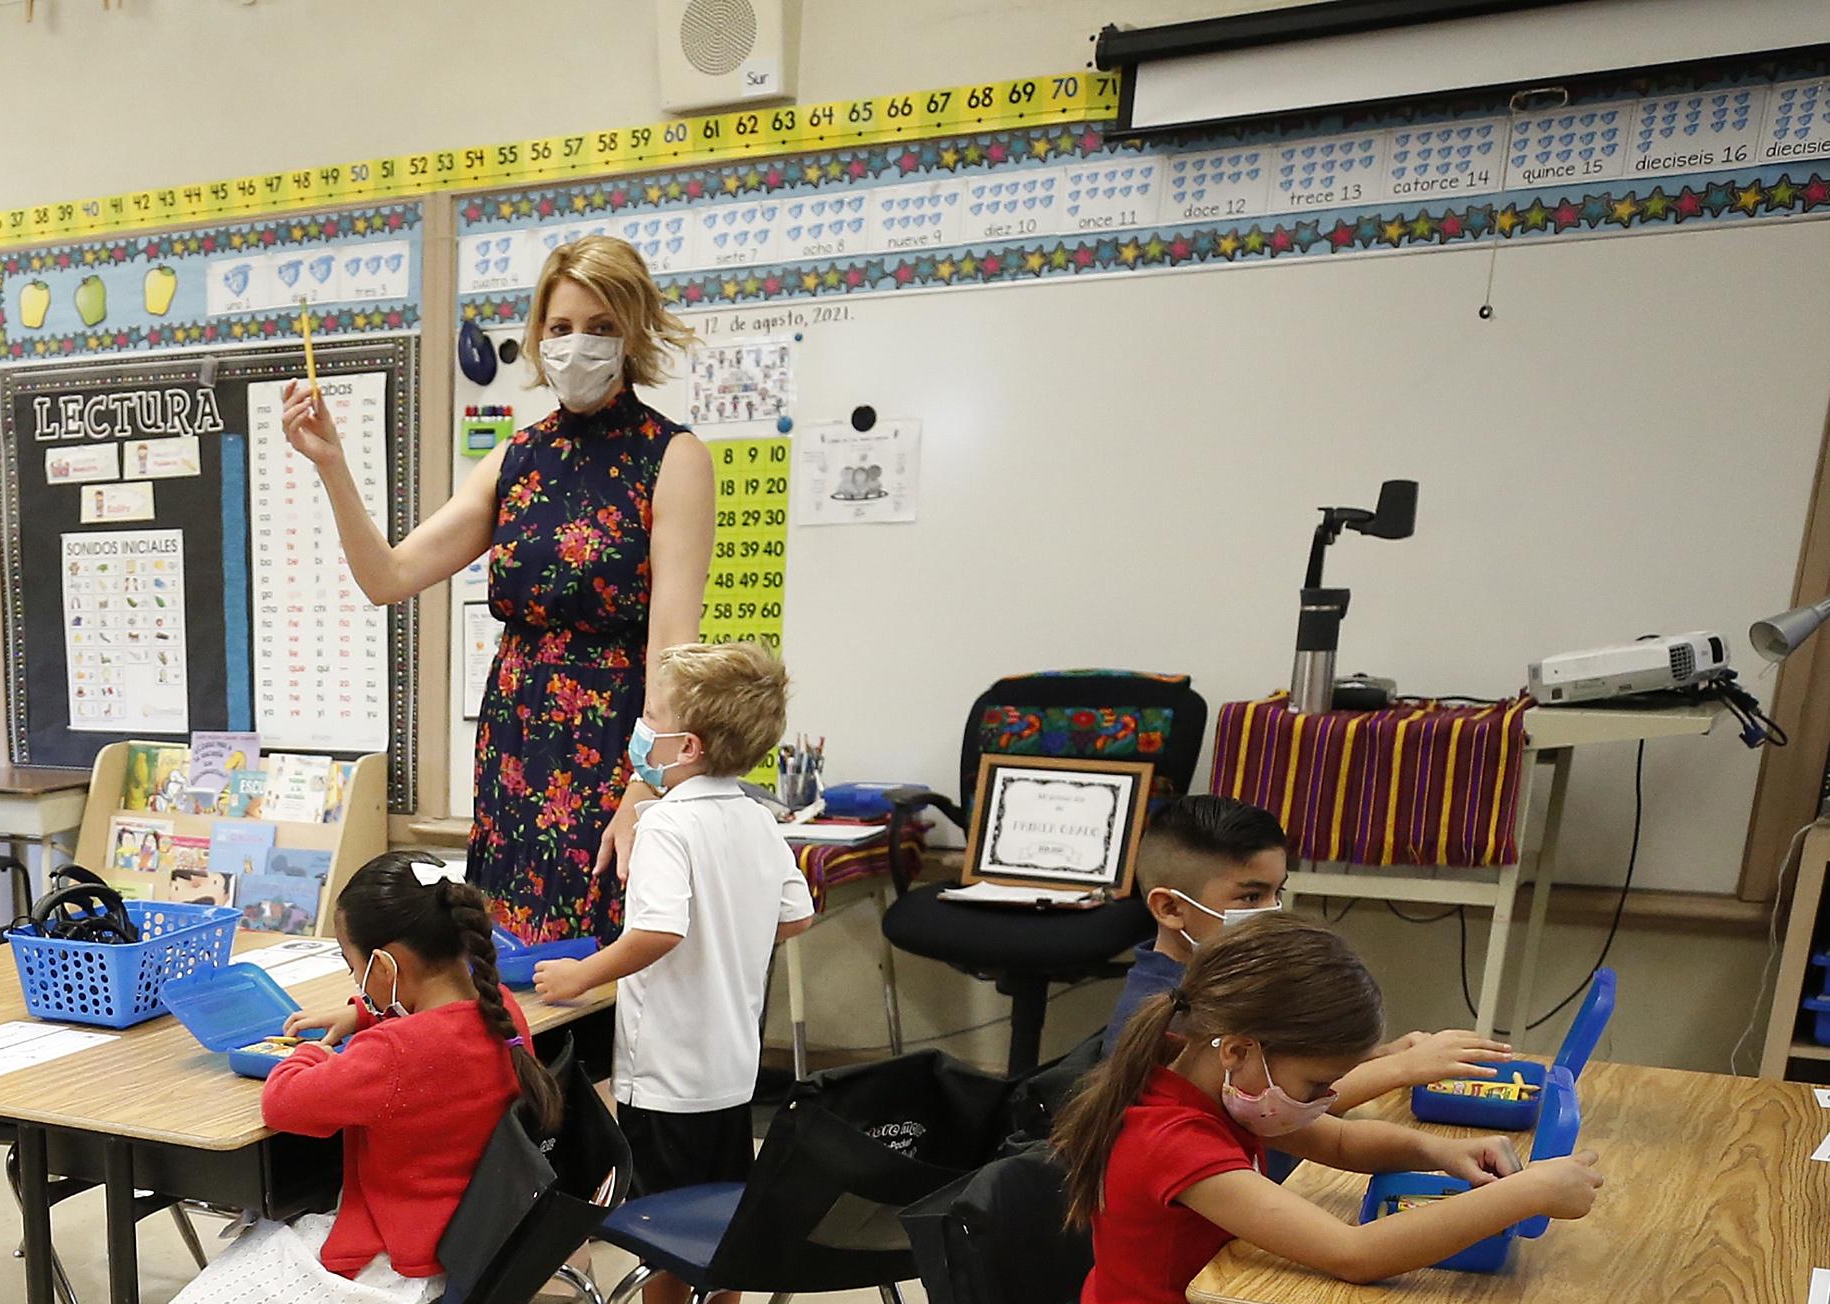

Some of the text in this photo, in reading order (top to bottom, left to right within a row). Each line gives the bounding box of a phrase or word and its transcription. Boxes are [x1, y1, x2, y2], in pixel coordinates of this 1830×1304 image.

[747, 72, 769, 87] Sur
[563, 78, 1118, 156] 57 58 59 60 61 62 63 64 65 66 67 68 69 70 71
[1766, 137, 1830, 157] diecisie
[1635, 145, 1748, 171] dieciseis 16
[1522, 159, 1603, 183] quince 15
[1393, 170, 1489, 194] catorce 14
[1290, 184, 1362, 205] trece 13
[1183, 199, 1246, 217] doce 12
[984, 219, 1036, 237] diez 10
[1079, 210, 1138, 229] once 11
[837, 240, 845, 253] 8
[888, 230, 942, 248] nueve 9
[715, 249, 758, 264] siete 7
[730, 315, 746, 332] de
[753, 310, 808, 335] agosto,
[33, 388, 224, 441] LECTURA
[724, 446, 786, 464] 8 9 10
[720, 478, 787, 496] 18 19 20
[717, 510, 785, 527] 28 29 30
[66, 539, 178, 556] SONIDOS INICIALES
[716, 541, 784, 558] 38 39 40
[715, 572, 783, 589] 48 49 50
[714, 602, 781, 619] 58 59 60
